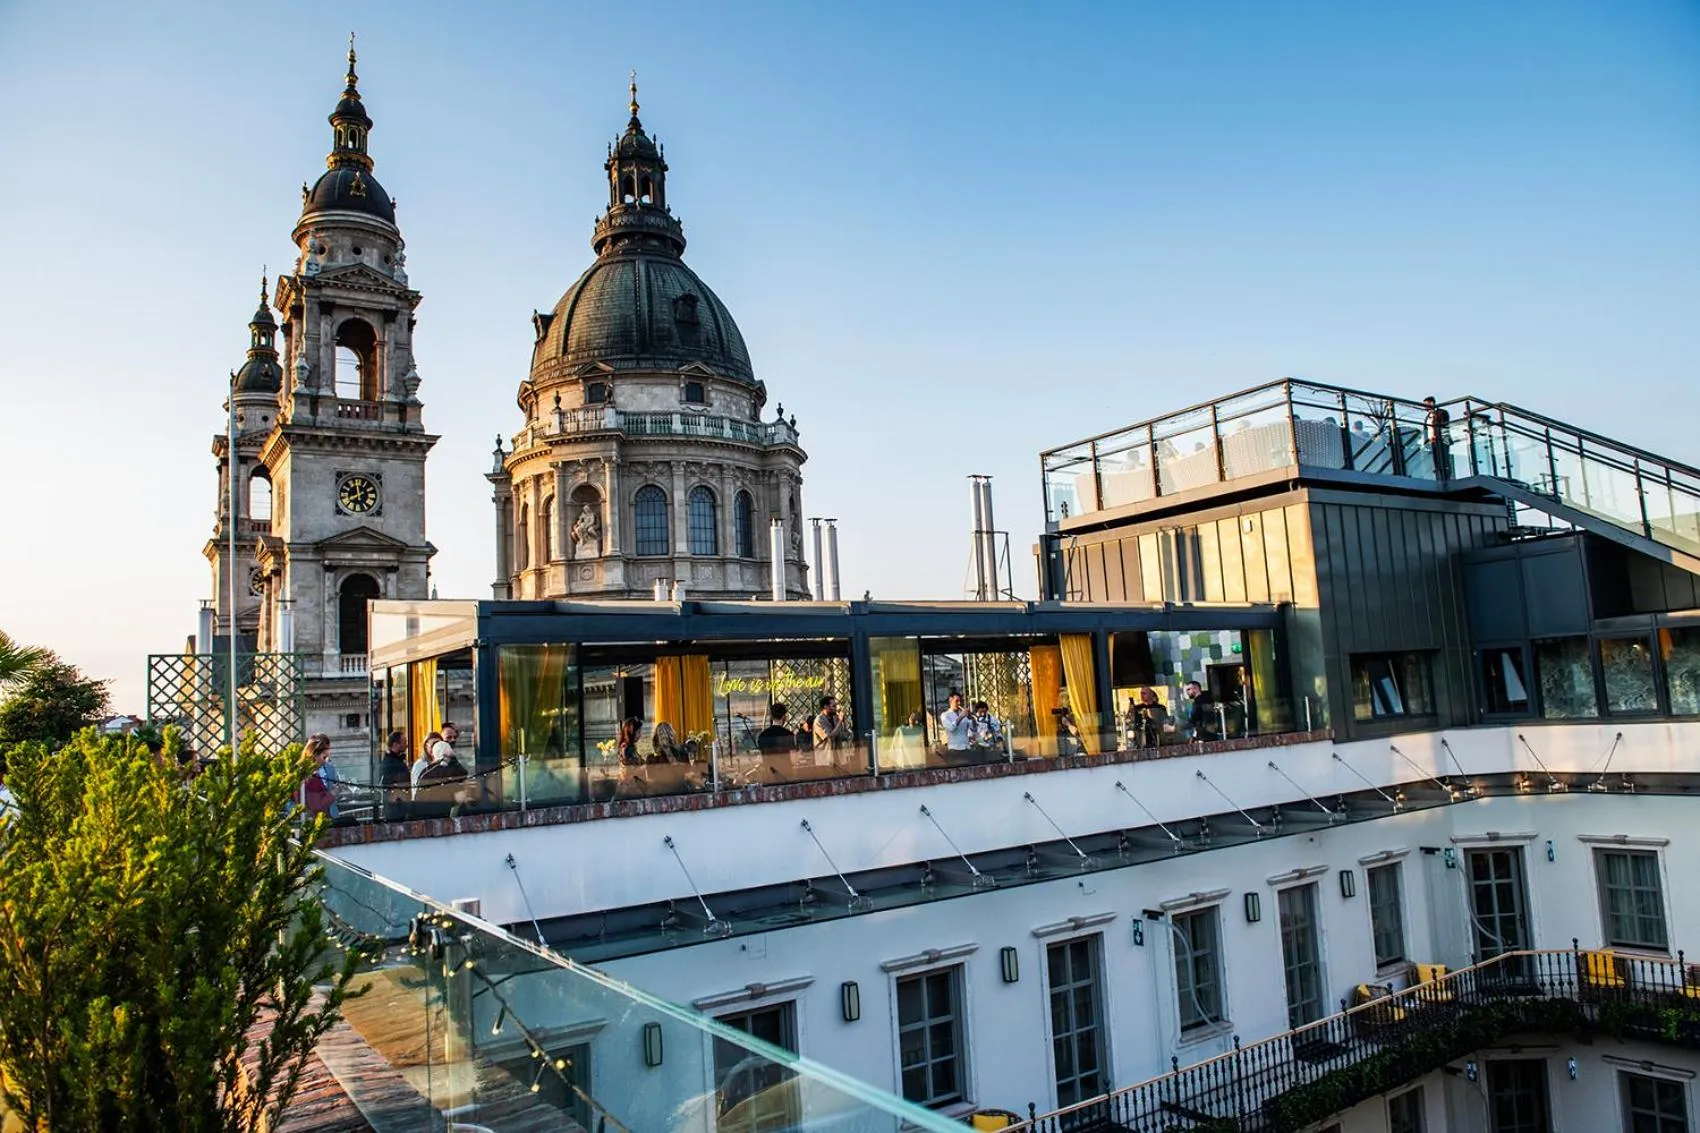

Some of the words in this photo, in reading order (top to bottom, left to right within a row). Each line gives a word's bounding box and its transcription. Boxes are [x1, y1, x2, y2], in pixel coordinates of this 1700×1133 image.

[717, 671, 747, 697] Love
[749, 679, 764, 692] is
[783, 669, 806, 688] the
[806, 677, 825, 689] air
